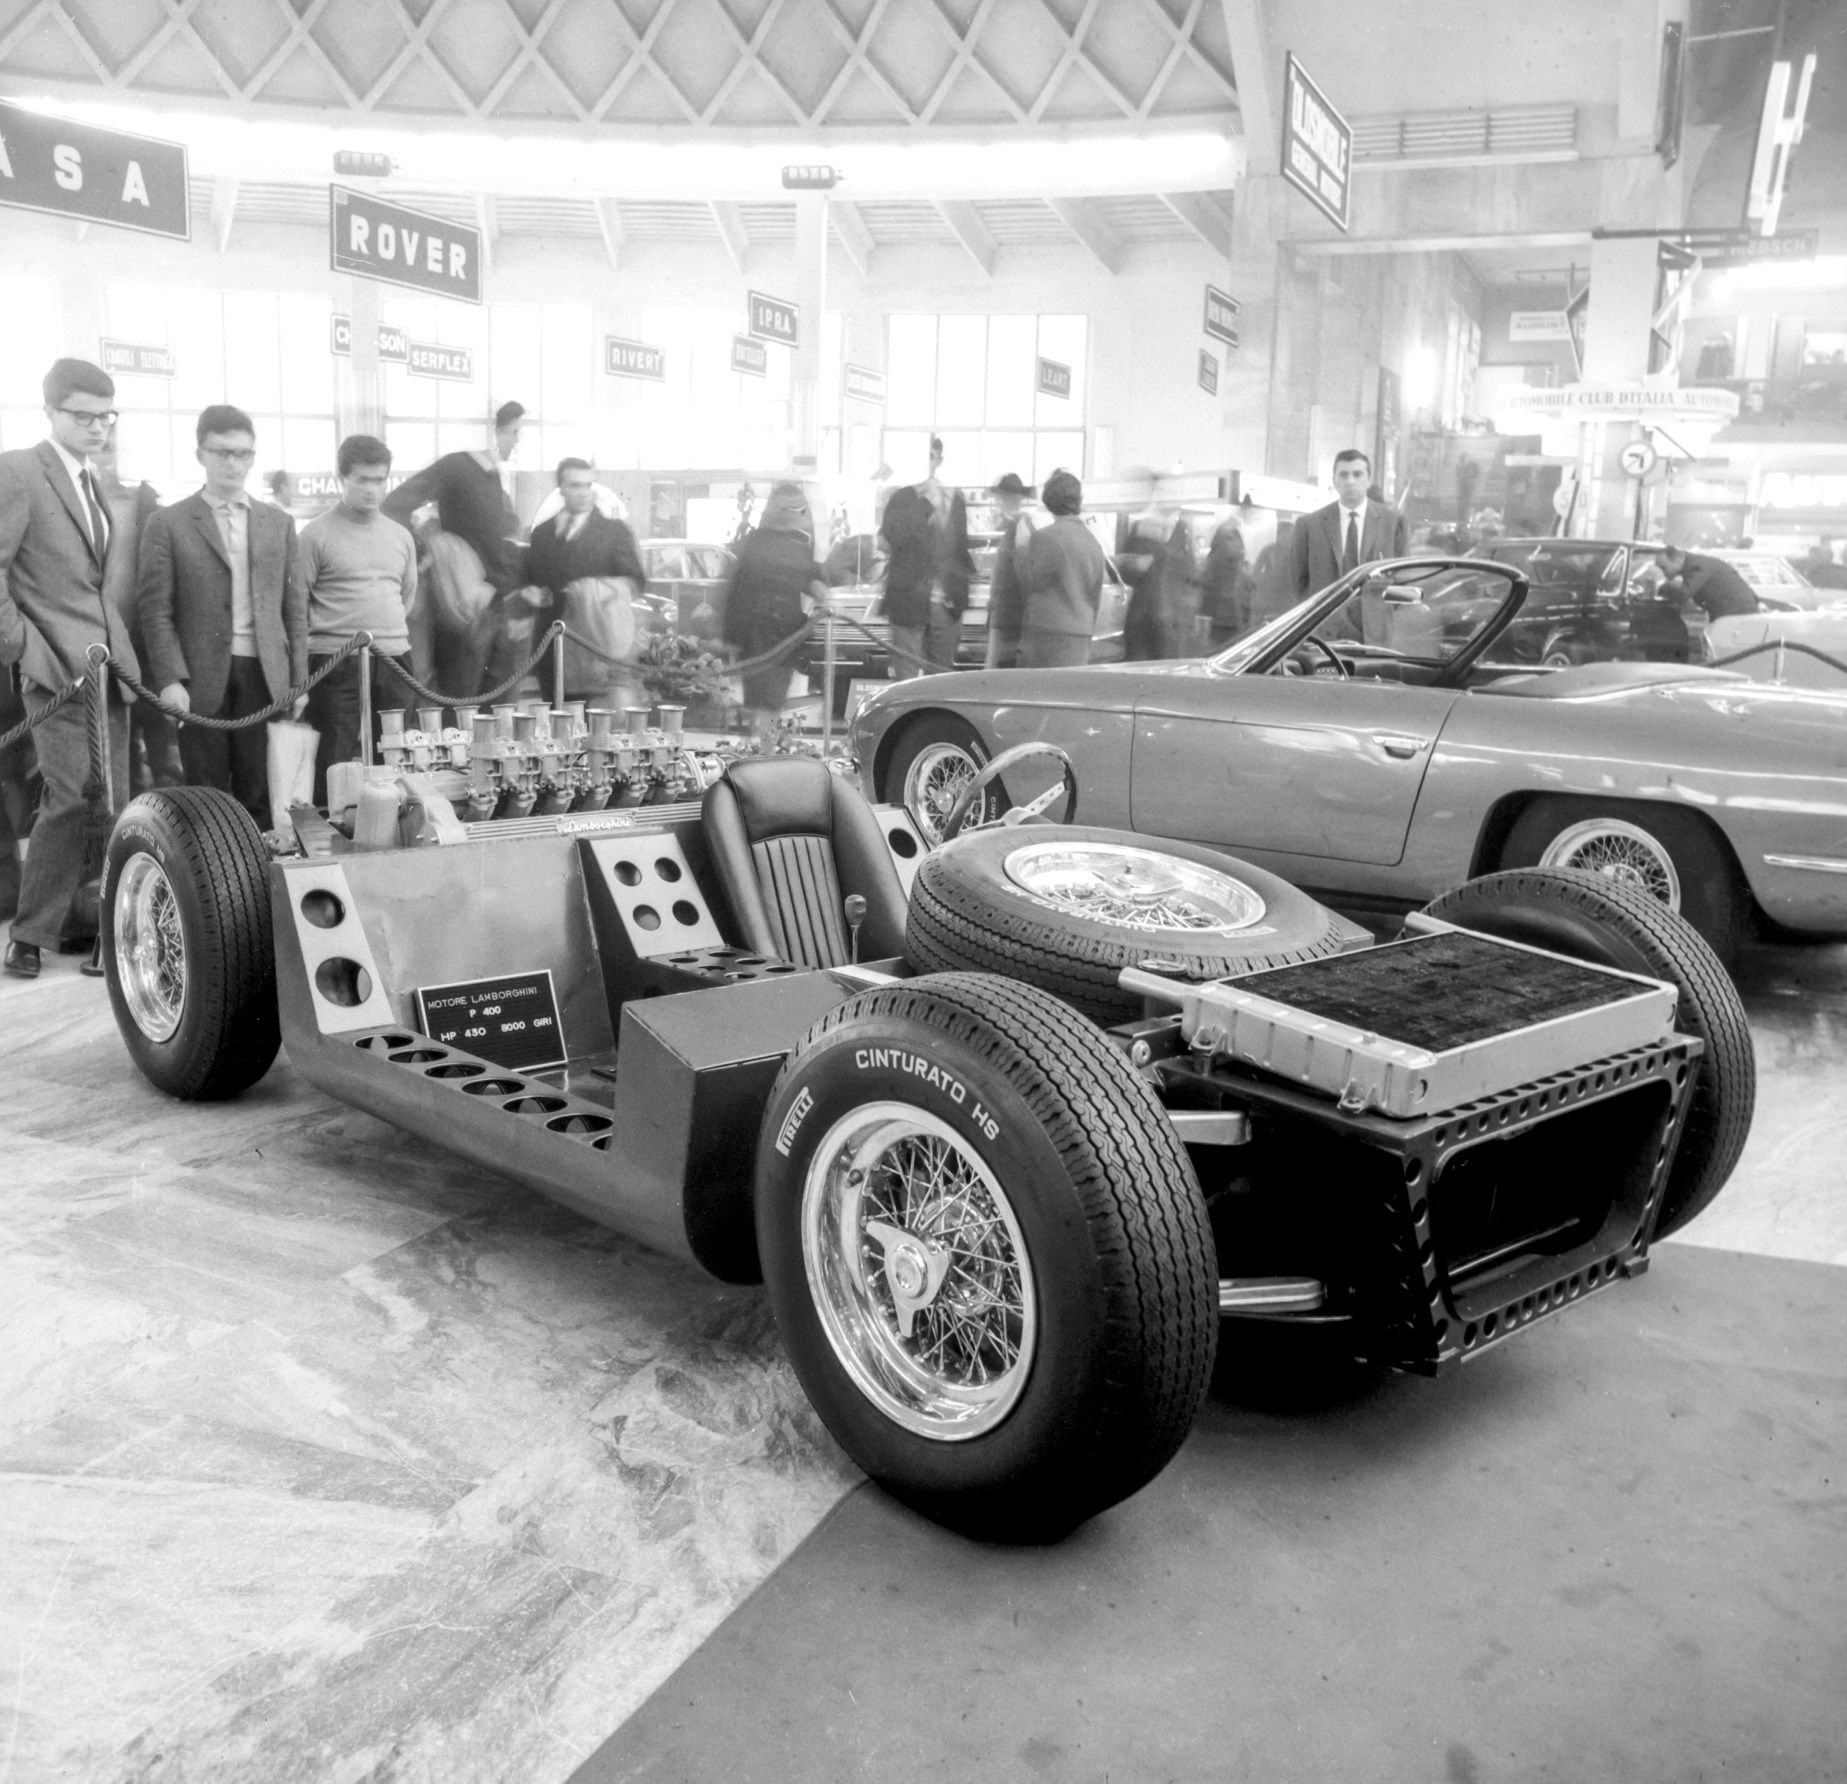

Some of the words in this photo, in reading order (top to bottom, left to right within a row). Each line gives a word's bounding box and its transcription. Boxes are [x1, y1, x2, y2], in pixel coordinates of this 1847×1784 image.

[350, 213, 466, 280] ROVER
[412, 349, 472, 374] SERFLEX
[612, 347, 661, 372] RIVERT
[1578, 391, 1614, 405] CLUB
[427, 995, 468, 1010] MOTORE
[470, 986, 538, 1004] LAMBORGHINI
[469, 1008, 477, 1018] P
[482, 1005, 502, 1016] 400
[440, 1031, 457, 1042] HP
[500, 1020, 526, 1033] 8000
[533, 1016, 552, 1028] GIRI
[855, 1048, 966, 1104] CINTURATO
[971, 1102, 1000, 1141] HS
[775, 1085, 815, 1158] PIRELLI
